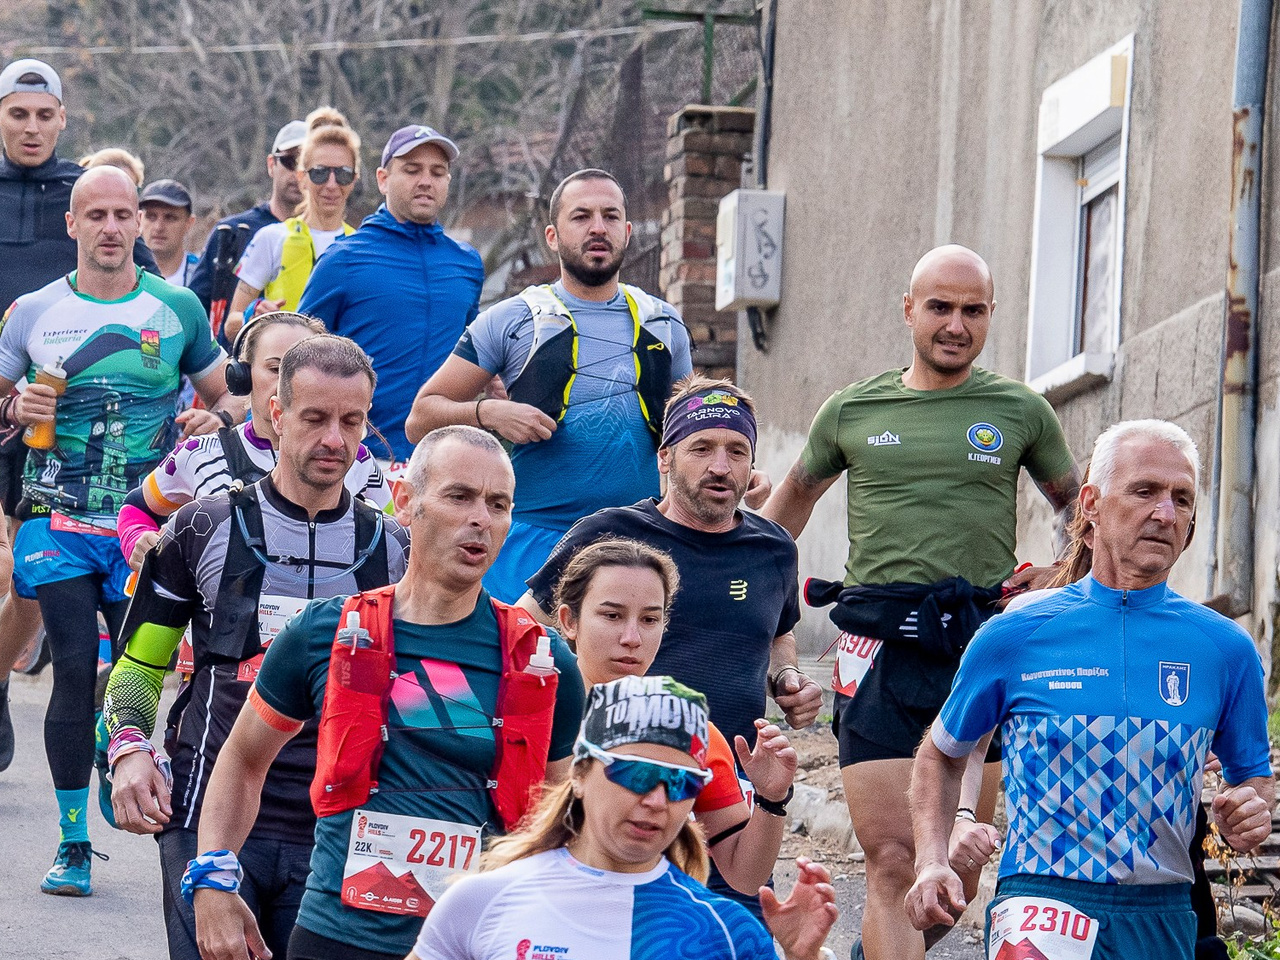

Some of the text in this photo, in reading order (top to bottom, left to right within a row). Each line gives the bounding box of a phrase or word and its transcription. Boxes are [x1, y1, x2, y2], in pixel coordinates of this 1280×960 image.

[43, 328, 88, 337] Experience
[686, 407, 740, 419] TARNOVO
[695, 413, 731, 421] ULTRA
[605, 700, 628, 729] TO
[368, 822, 389, 830] PLOVDIV
[354, 841, 372, 853] 22K
[406, 828, 477, 871] 2217
[1020, 905, 1091, 942] 2310
[533, 945, 569, 953] PLOVDIV
[532, 953, 555, 960] HILLS
